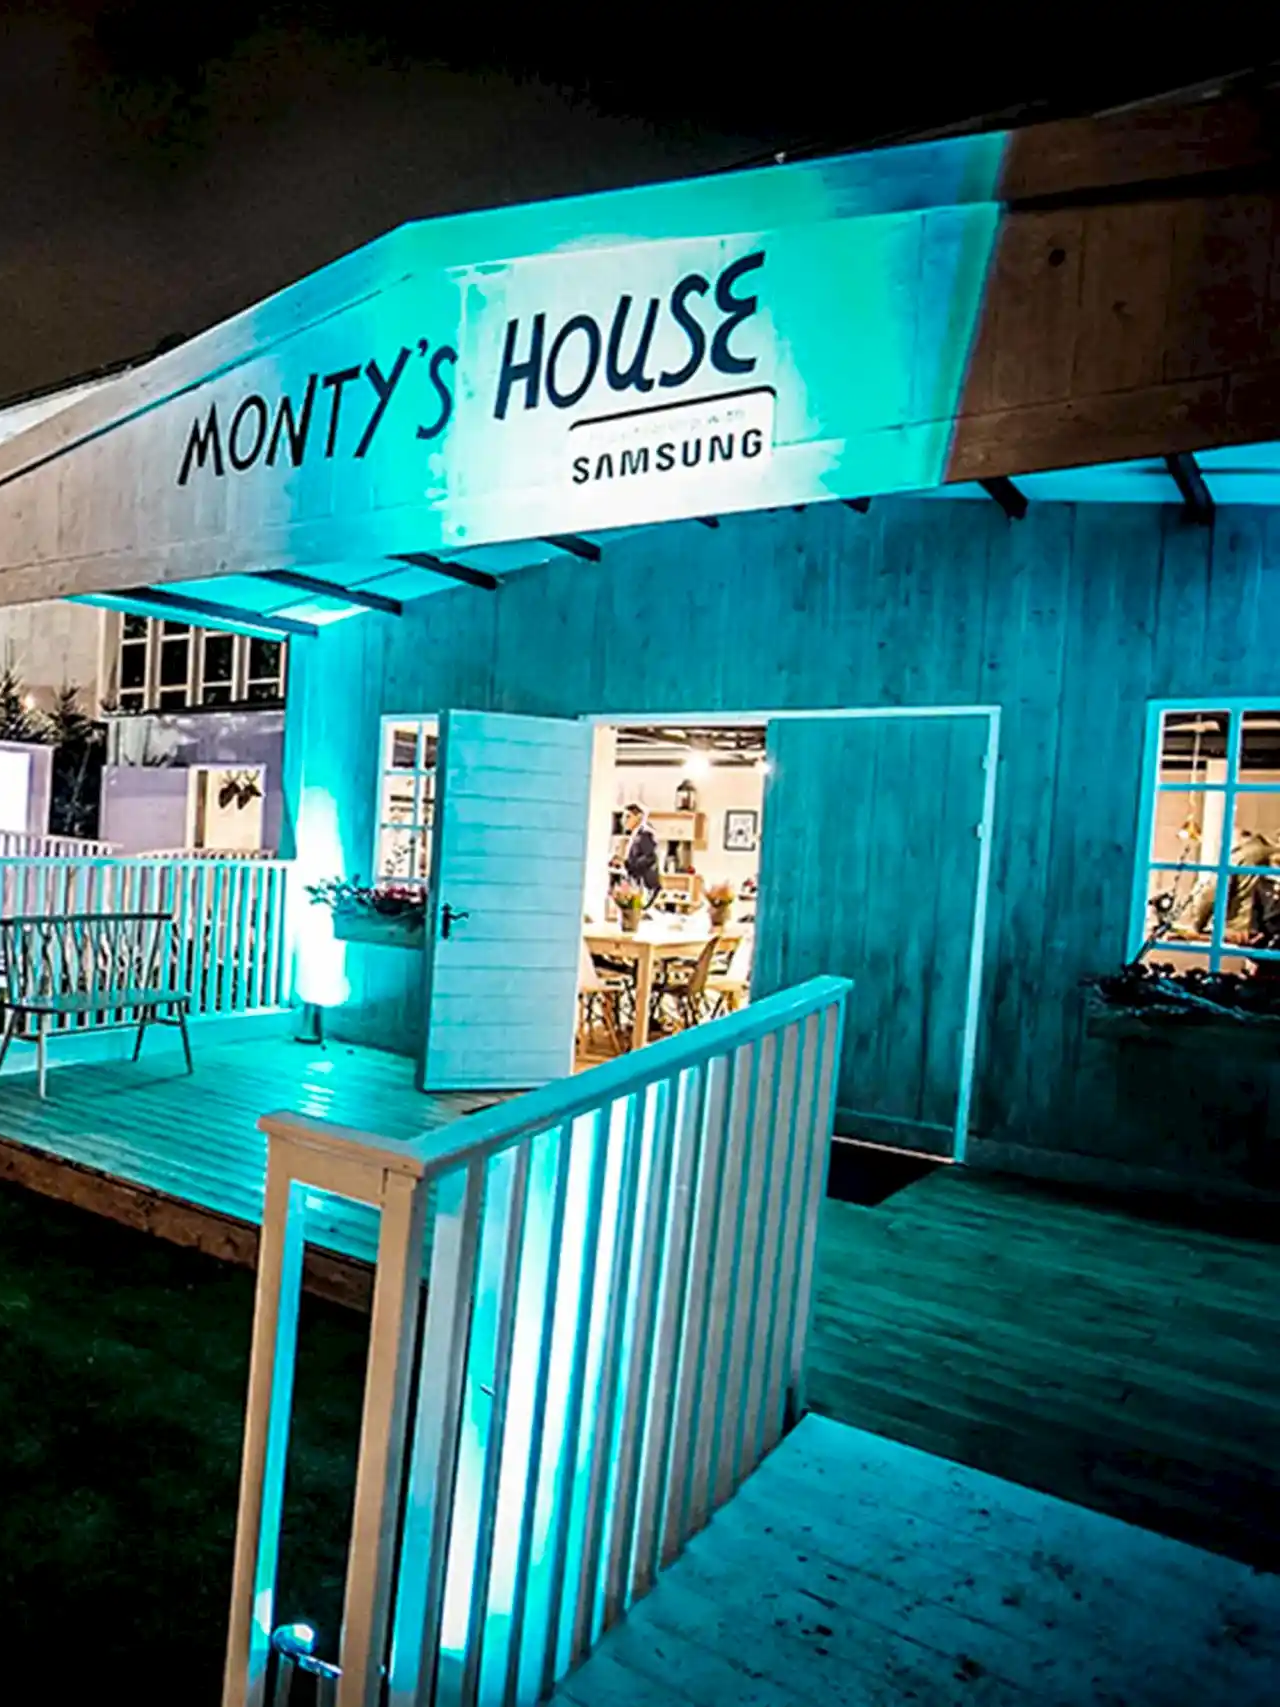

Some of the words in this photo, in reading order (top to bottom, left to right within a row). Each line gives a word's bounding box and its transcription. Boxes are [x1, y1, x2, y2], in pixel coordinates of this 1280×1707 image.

[177, 338, 459, 486] MONTY'S
[494, 250, 767, 420] HOUSE
[572, 429, 764, 484] SAMSUNG
